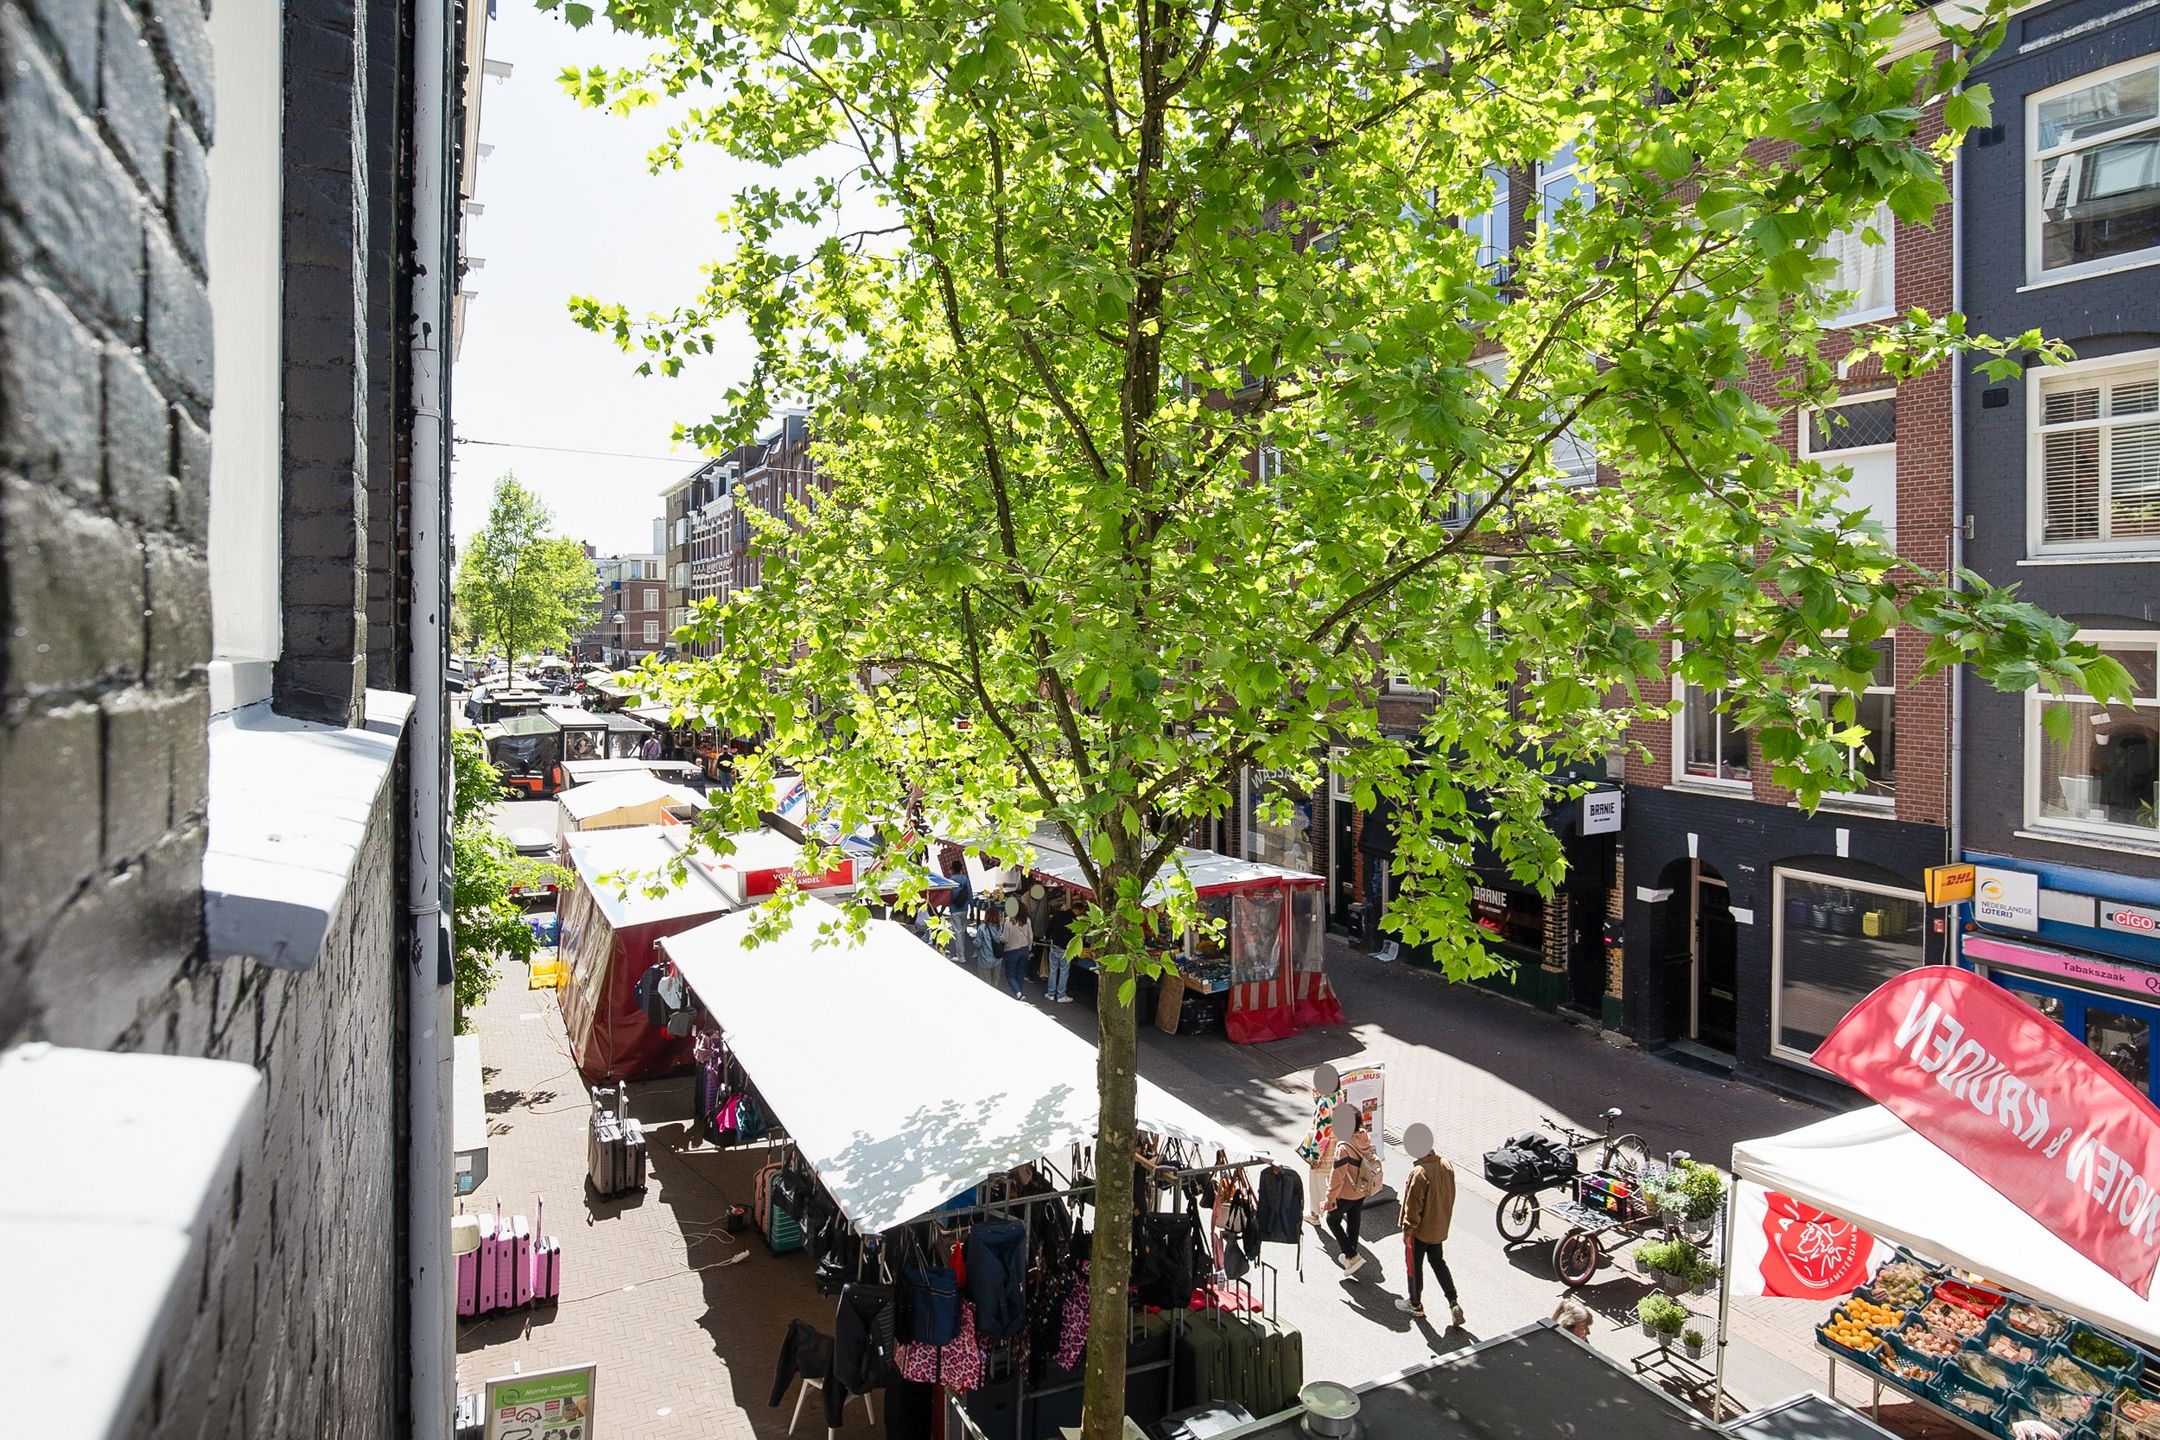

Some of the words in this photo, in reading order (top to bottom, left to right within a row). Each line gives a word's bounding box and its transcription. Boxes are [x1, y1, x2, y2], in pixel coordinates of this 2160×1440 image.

[1590, 802, 1615, 816] BRANIE
[1946, 872, 1972, 887] DHL
[1473, 886, 1507, 907] BRANIE
[1981, 901, 2033, 916] NEDERLANDSE
[1981, 908, 2013, 919] LOTERIJ
[2063, 962, 2126, 983] Tabakszaak
[2145, 976, 2160, 995] Q
[1828, 1232, 1857, 1285] AMSTERDAM
[525, 1387, 550, 1396] Money
[550, 1383, 578, 1392] Transfer
